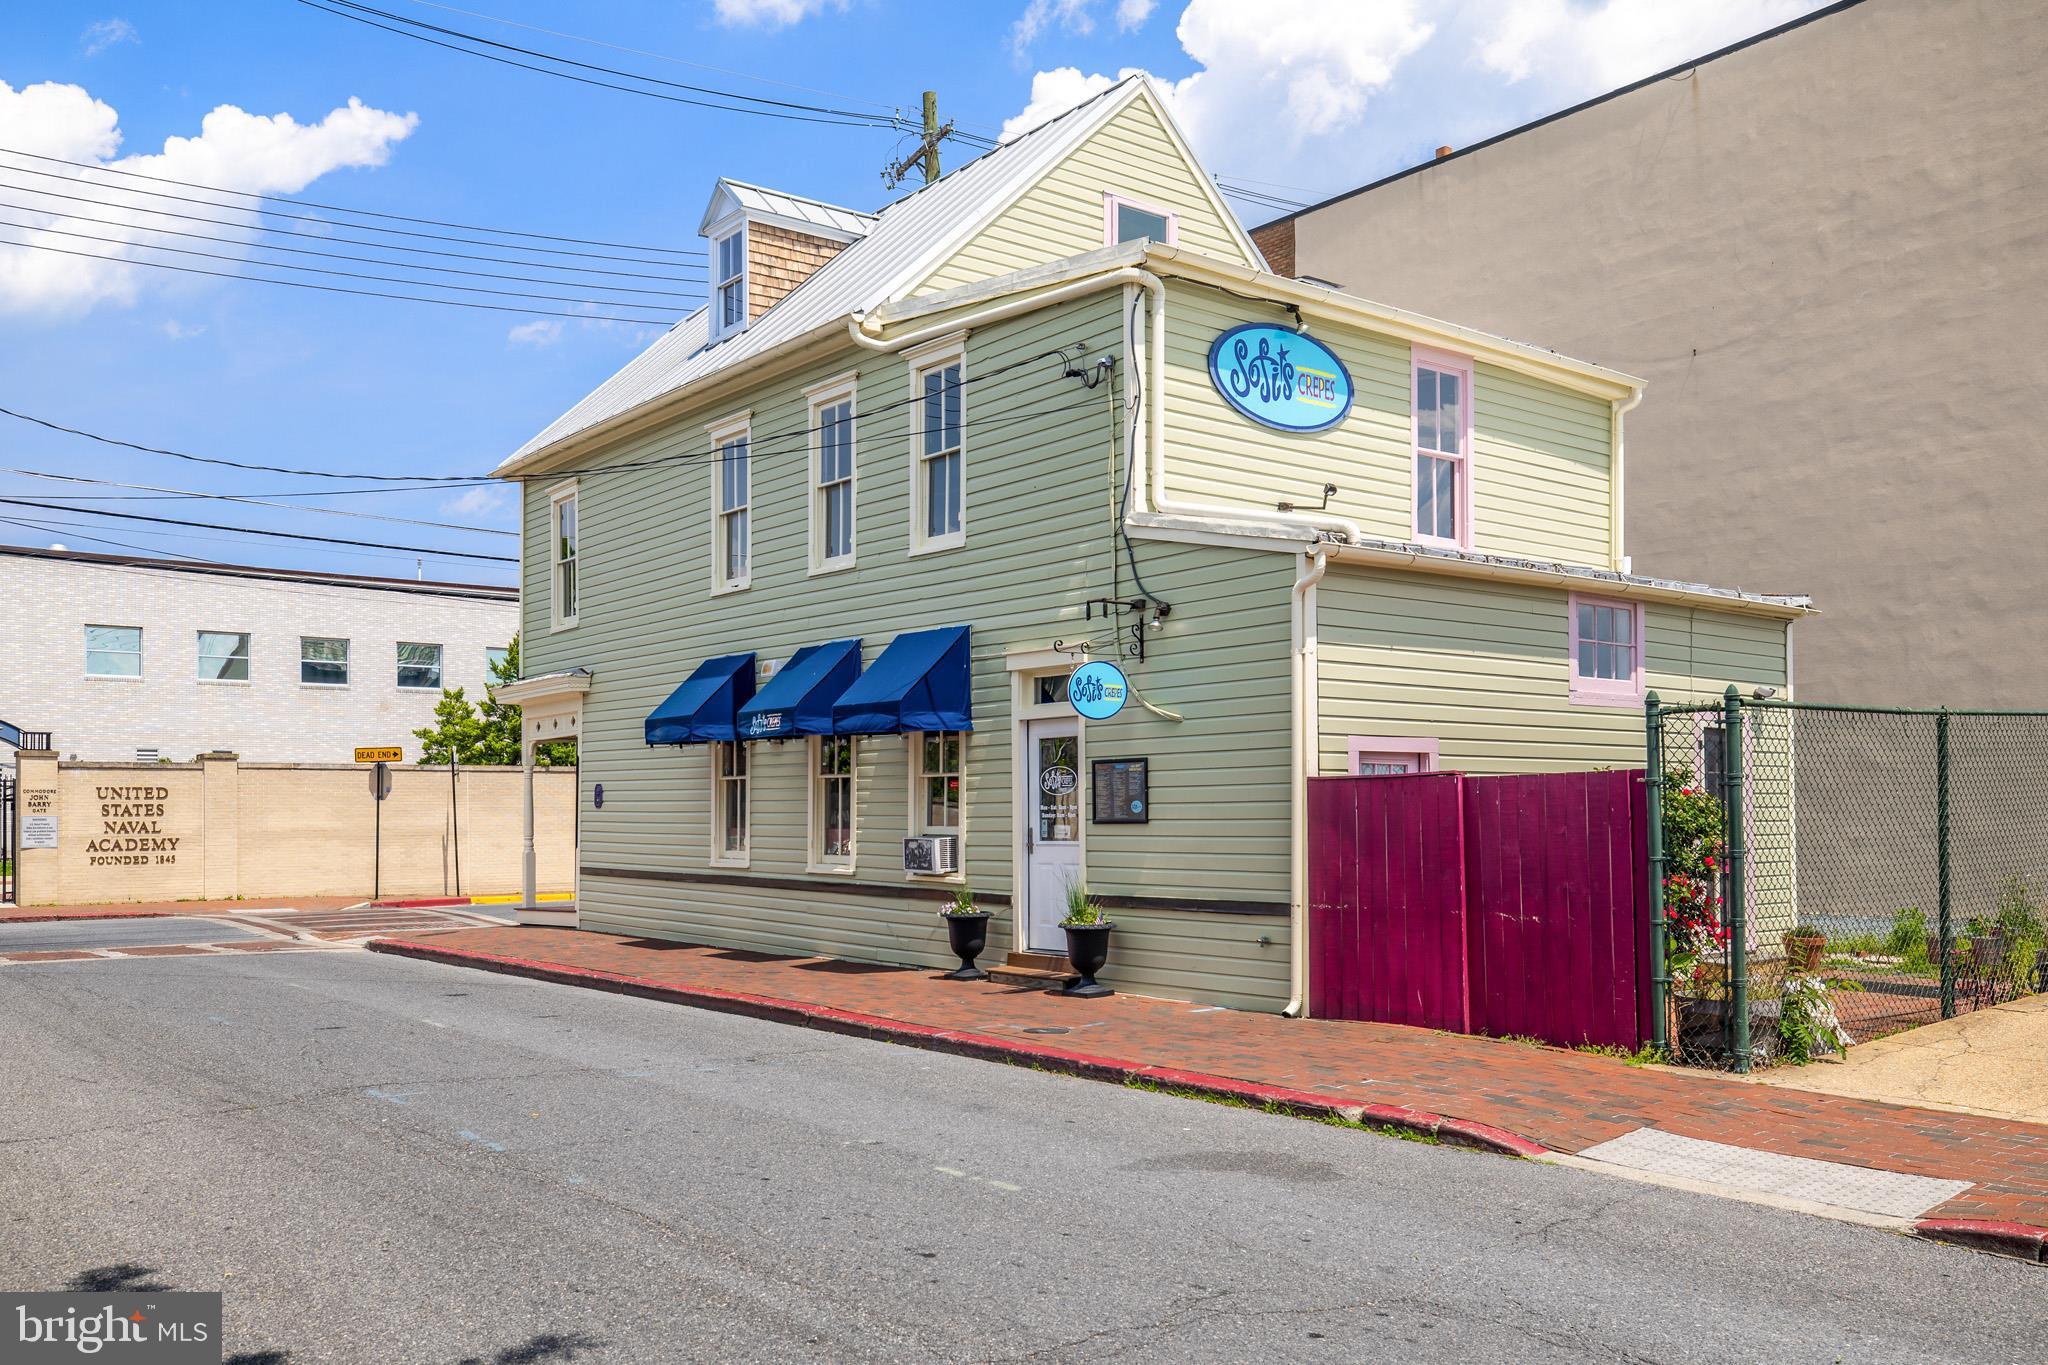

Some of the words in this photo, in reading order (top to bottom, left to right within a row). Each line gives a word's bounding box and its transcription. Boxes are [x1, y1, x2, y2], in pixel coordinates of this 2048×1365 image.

[1297, 373, 1335, 401] CREPES
[1104, 687, 1123, 698] CREPES
[357, 751, 375, 759] DEAD
[377, 751, 391, 759] END
[96, 786, 169, 800] UNITED
[101, 803, 164, 817] STATES
[103, 821, 162, 834] NAVAL
[86, 838, 180, 852] ACADEMY
[90, 856, 149, 866] FOUNDED
[155, 855, 176, 865] 1845
